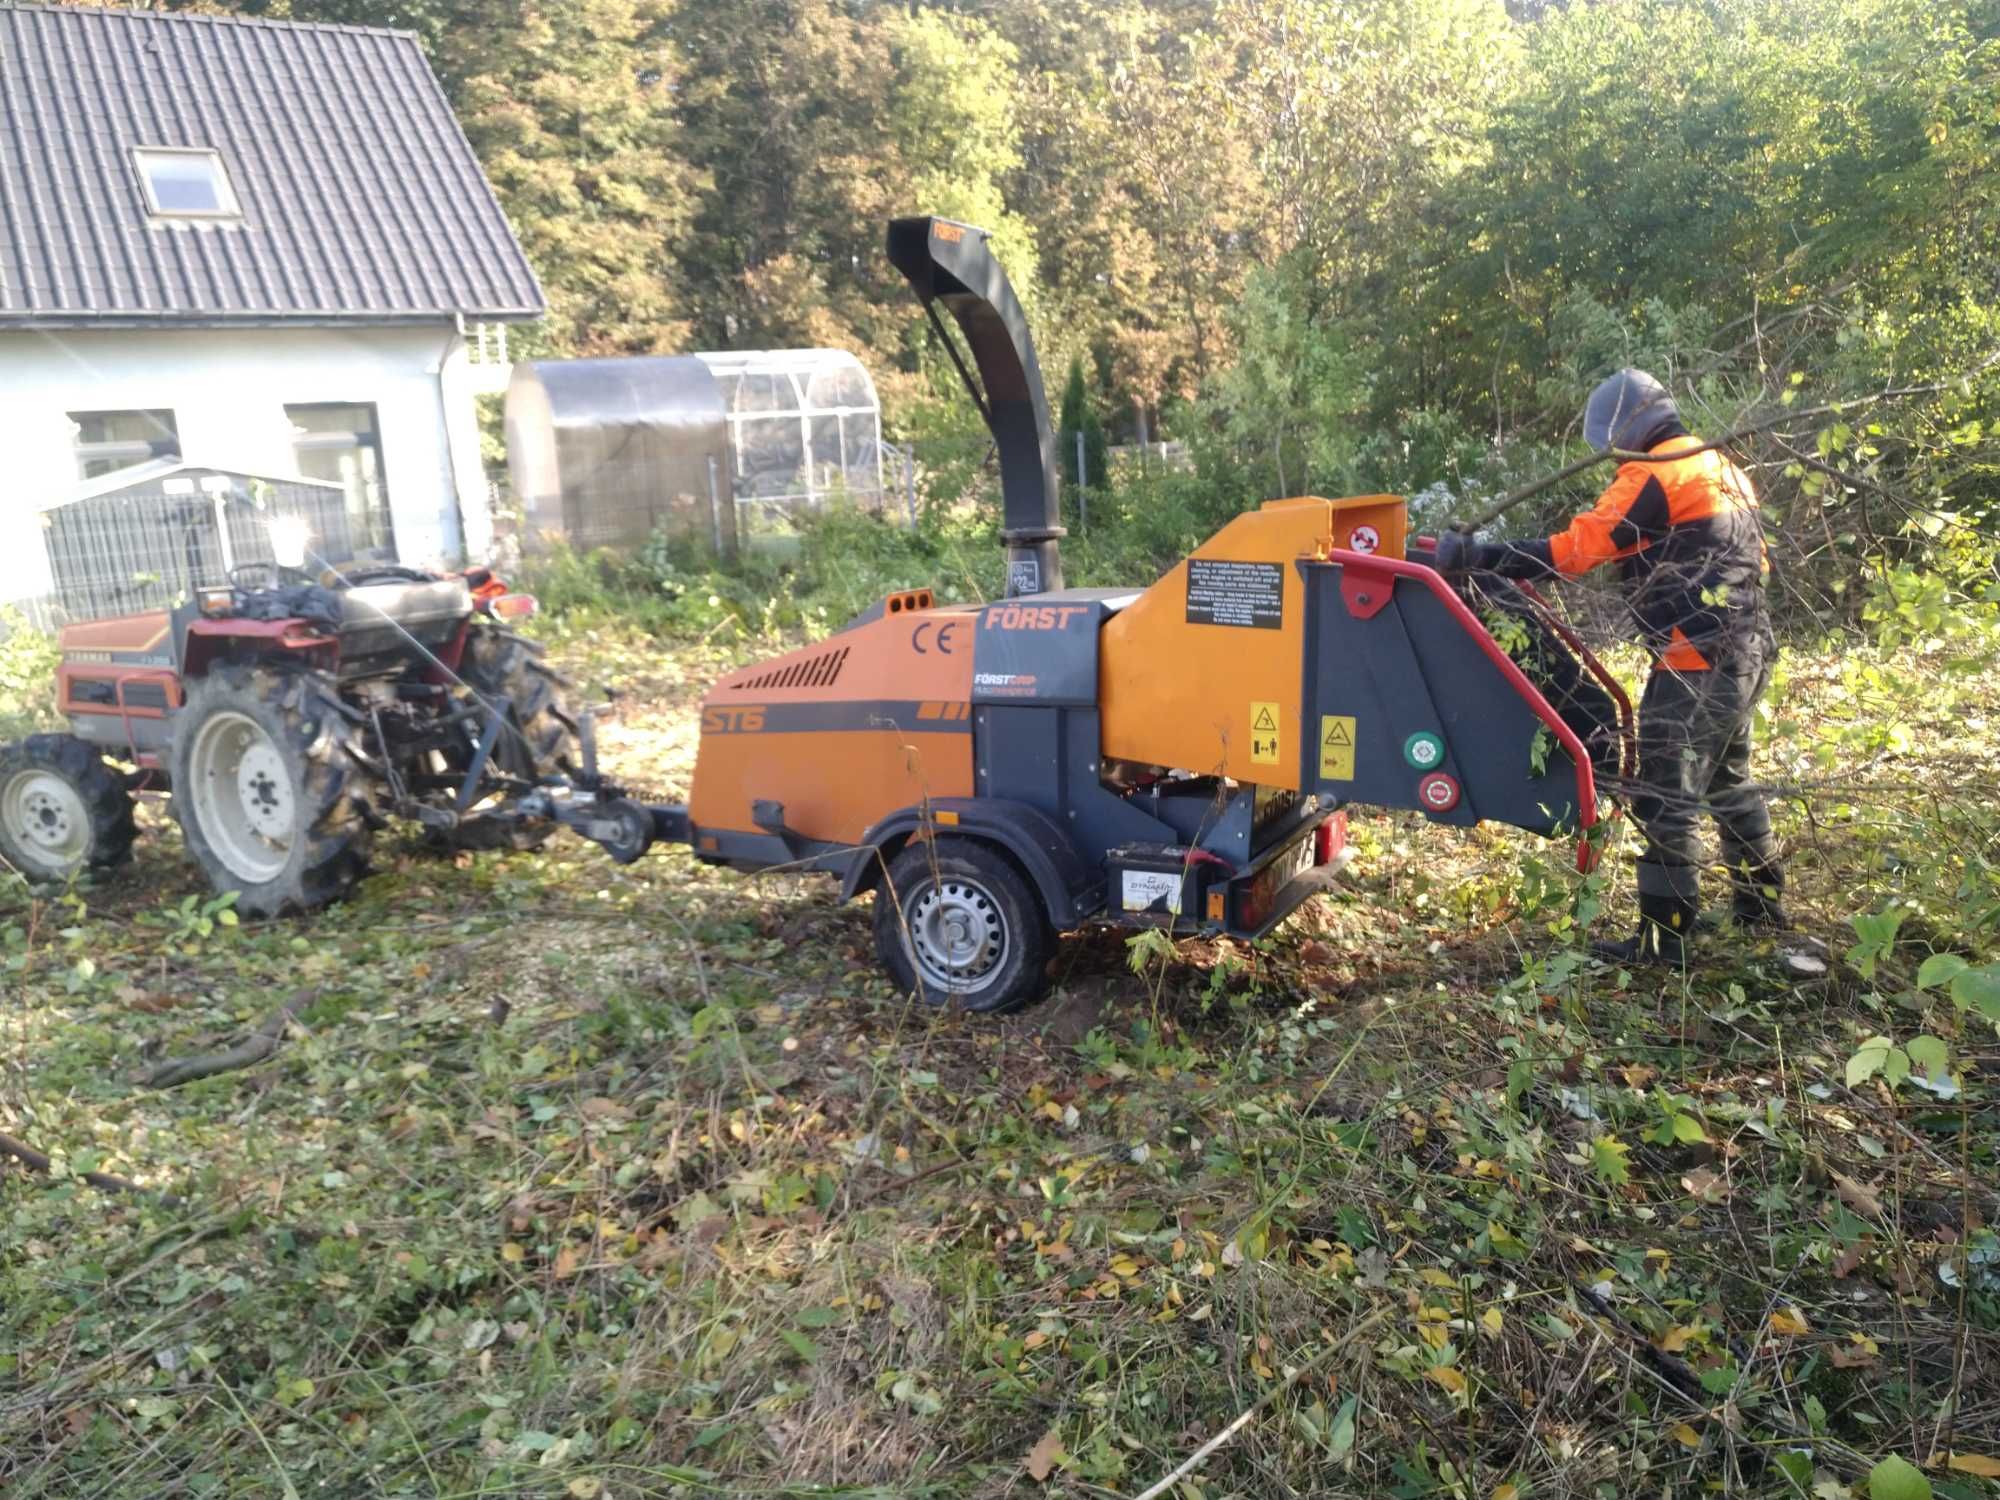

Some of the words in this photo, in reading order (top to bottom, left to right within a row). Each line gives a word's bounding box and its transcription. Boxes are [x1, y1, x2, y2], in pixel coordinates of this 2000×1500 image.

[985, 604, 1085, 629] FÖRST
[911, 621, 958, 654] CE
[702, 705, 766, 733] ST6
